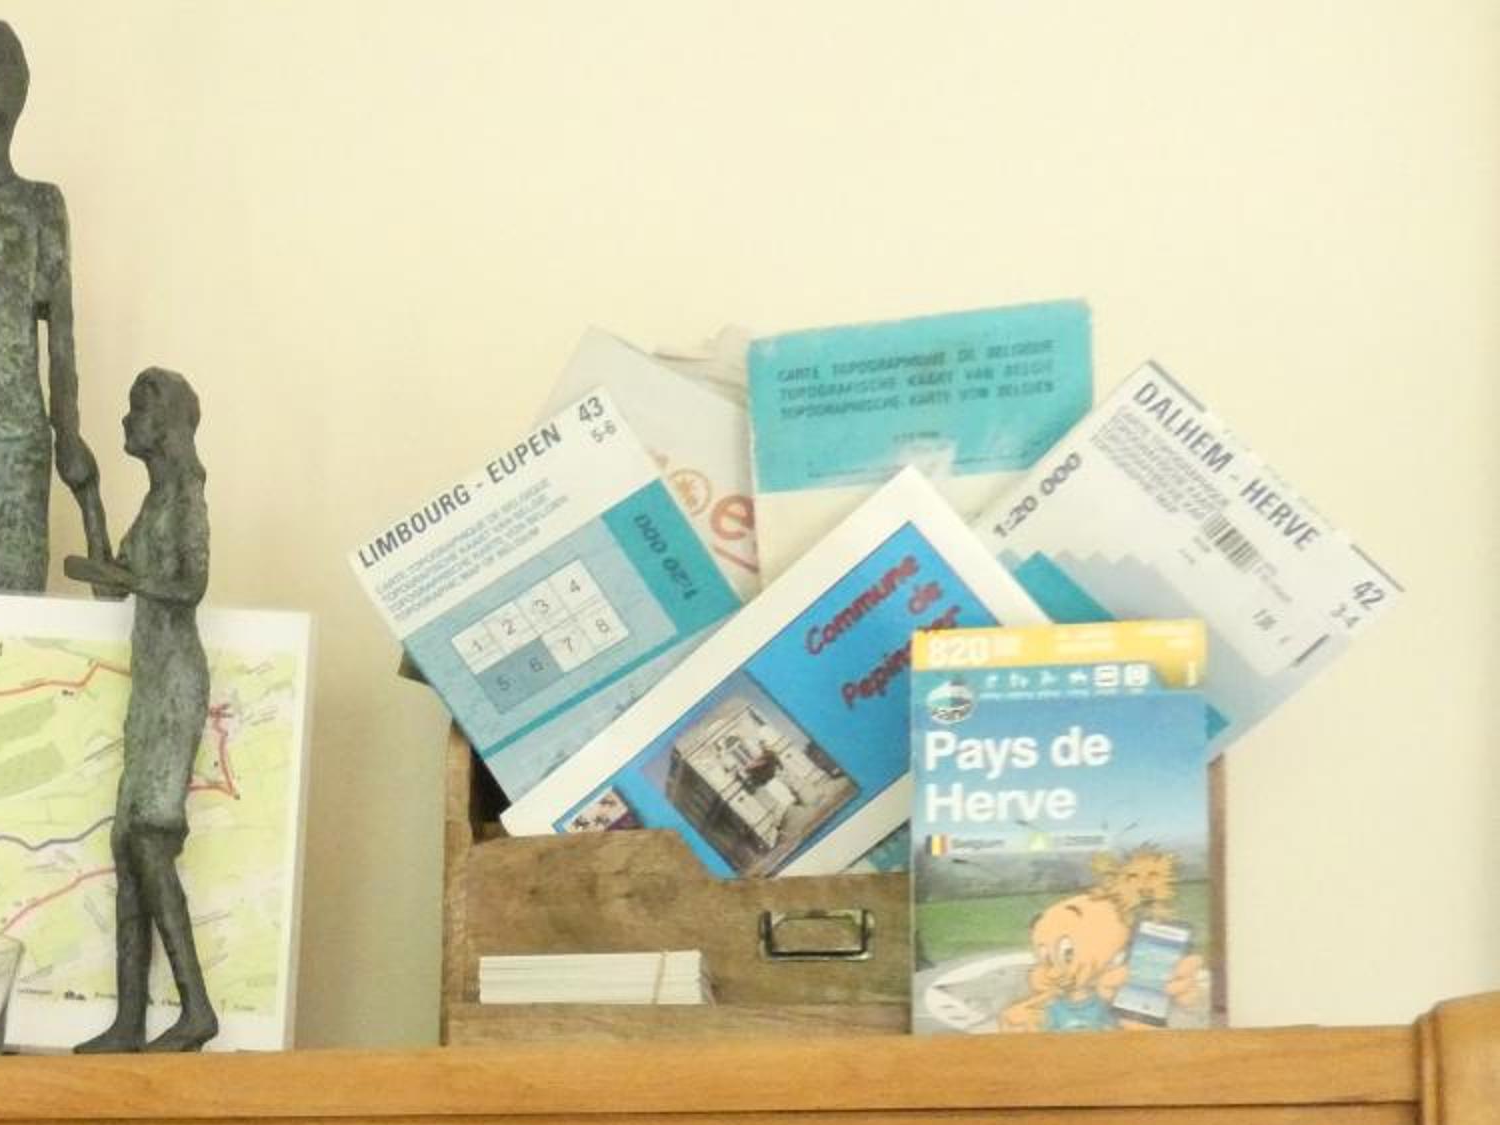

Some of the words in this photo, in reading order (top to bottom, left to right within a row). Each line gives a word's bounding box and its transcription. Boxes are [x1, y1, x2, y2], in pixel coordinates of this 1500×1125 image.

[578, 396, 604, 423] 43
[1133, 381, 1234, 473] DALHEM
[1239, 478, 1321, 552] HERVE
[358, 483, 471, 568] LIMBOURG
[486, 423, 562, 484] EUPEN
[569, 579, 581, 593] 4
[1352, 580, 1386, 610] 42
[532, 599, 548, 615] 3
[805, 555, 919, 656] Commune
[501, 619, 517, 636] 2
[595, 618, 611, 634] 8
[471, 639, 484, 652] 1
[561, 637, 574, 653] 7
[529, 657, 545, 673] 6
[925, 730, 1039, 780] Pays
[1051, 725, 1113, 767] de
[925, 782, 1077, 823] Herve
